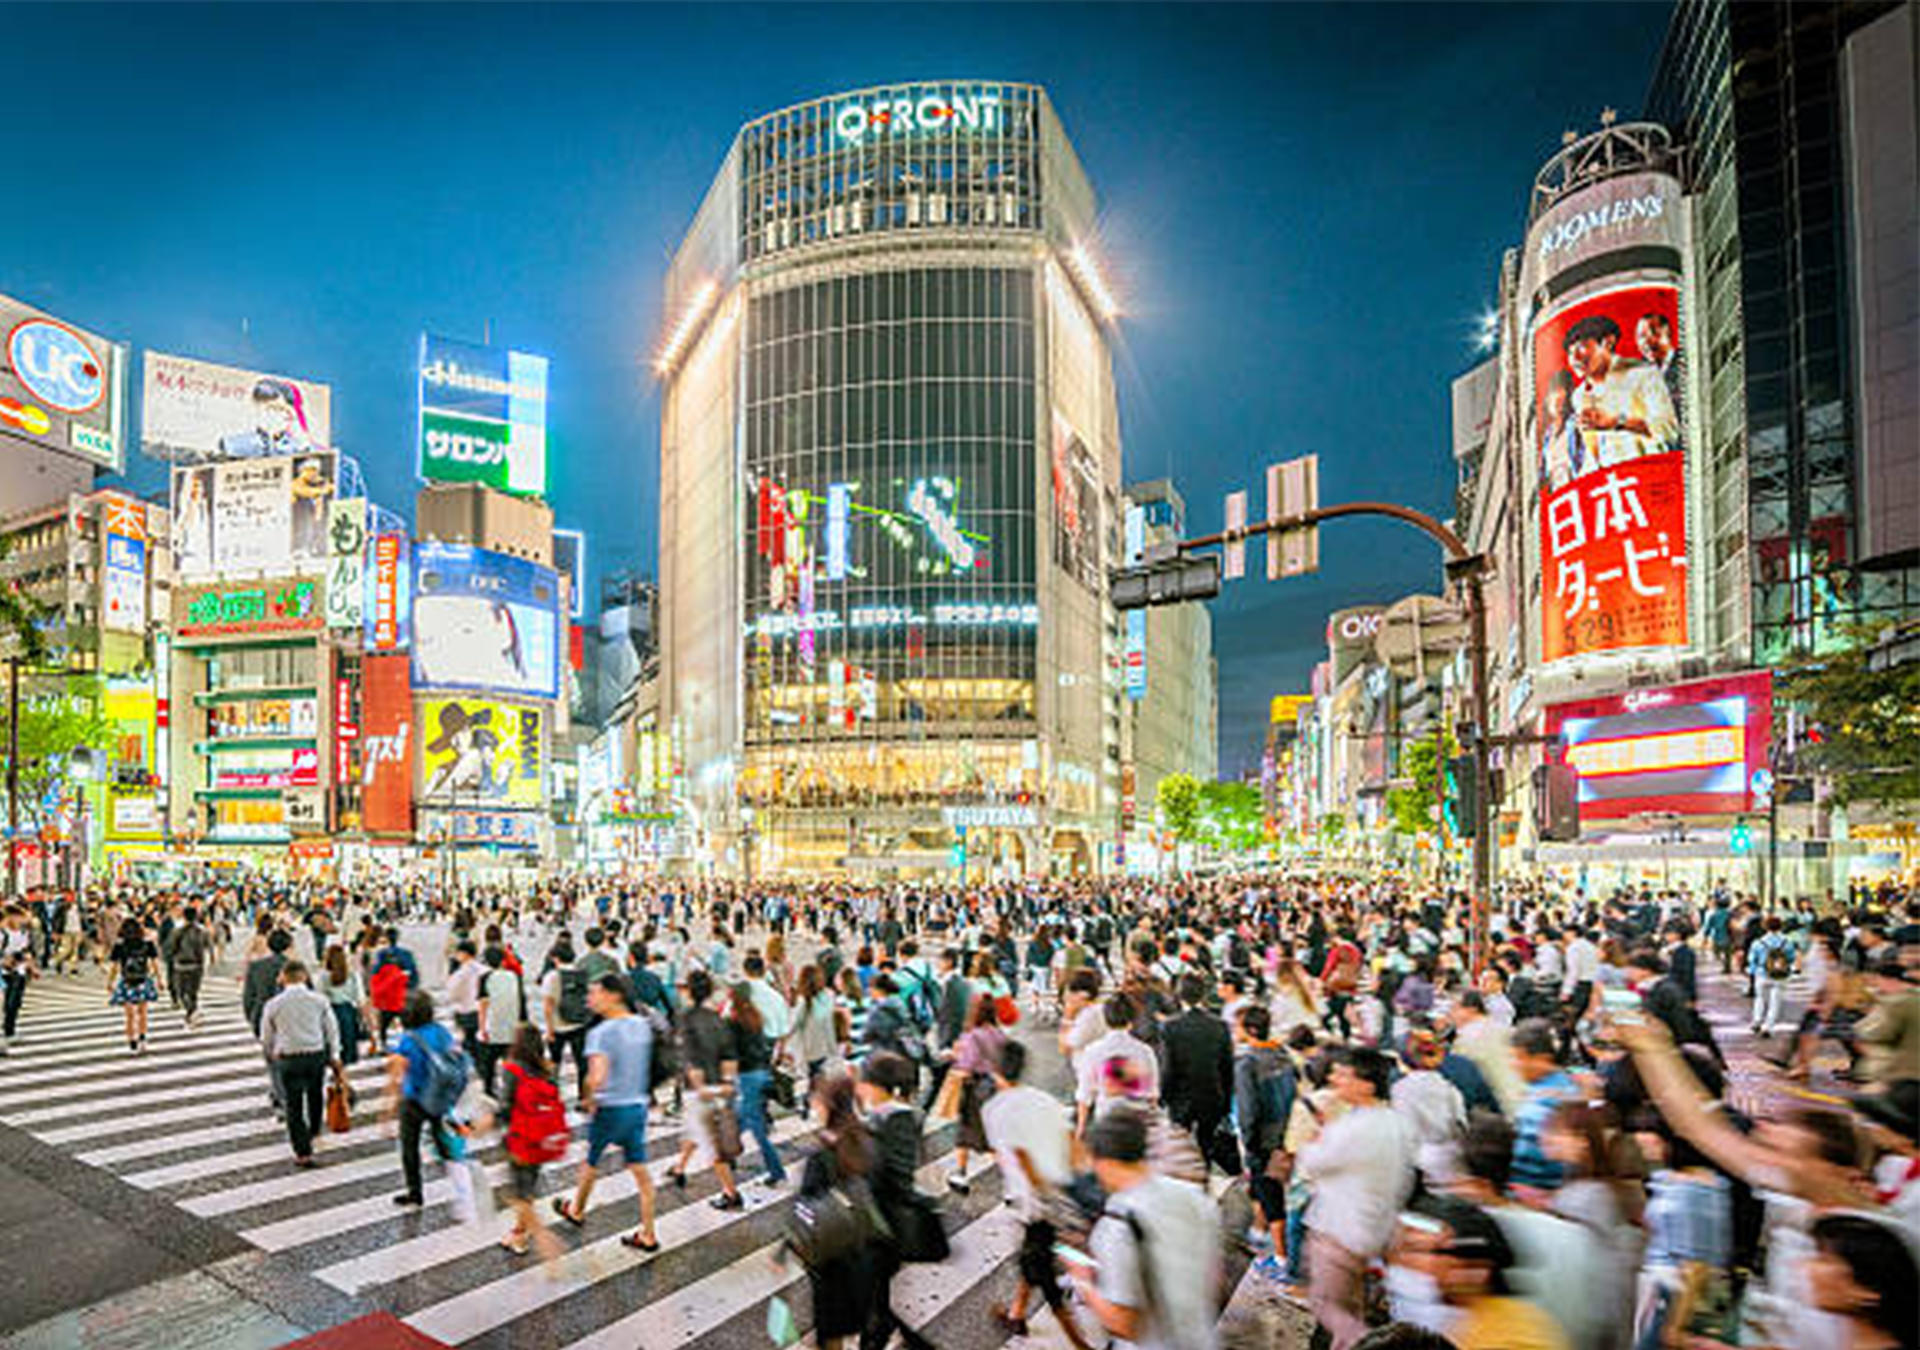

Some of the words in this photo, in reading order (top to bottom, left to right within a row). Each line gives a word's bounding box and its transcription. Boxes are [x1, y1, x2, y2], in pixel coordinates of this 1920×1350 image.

[836, 95, 1000, 147] QFRONT
[1549, 472, 1649, 557] 日本
[1556, 533, 1688, 620] ダービー
[941, 805, 1036, 827] TSUTAYA
